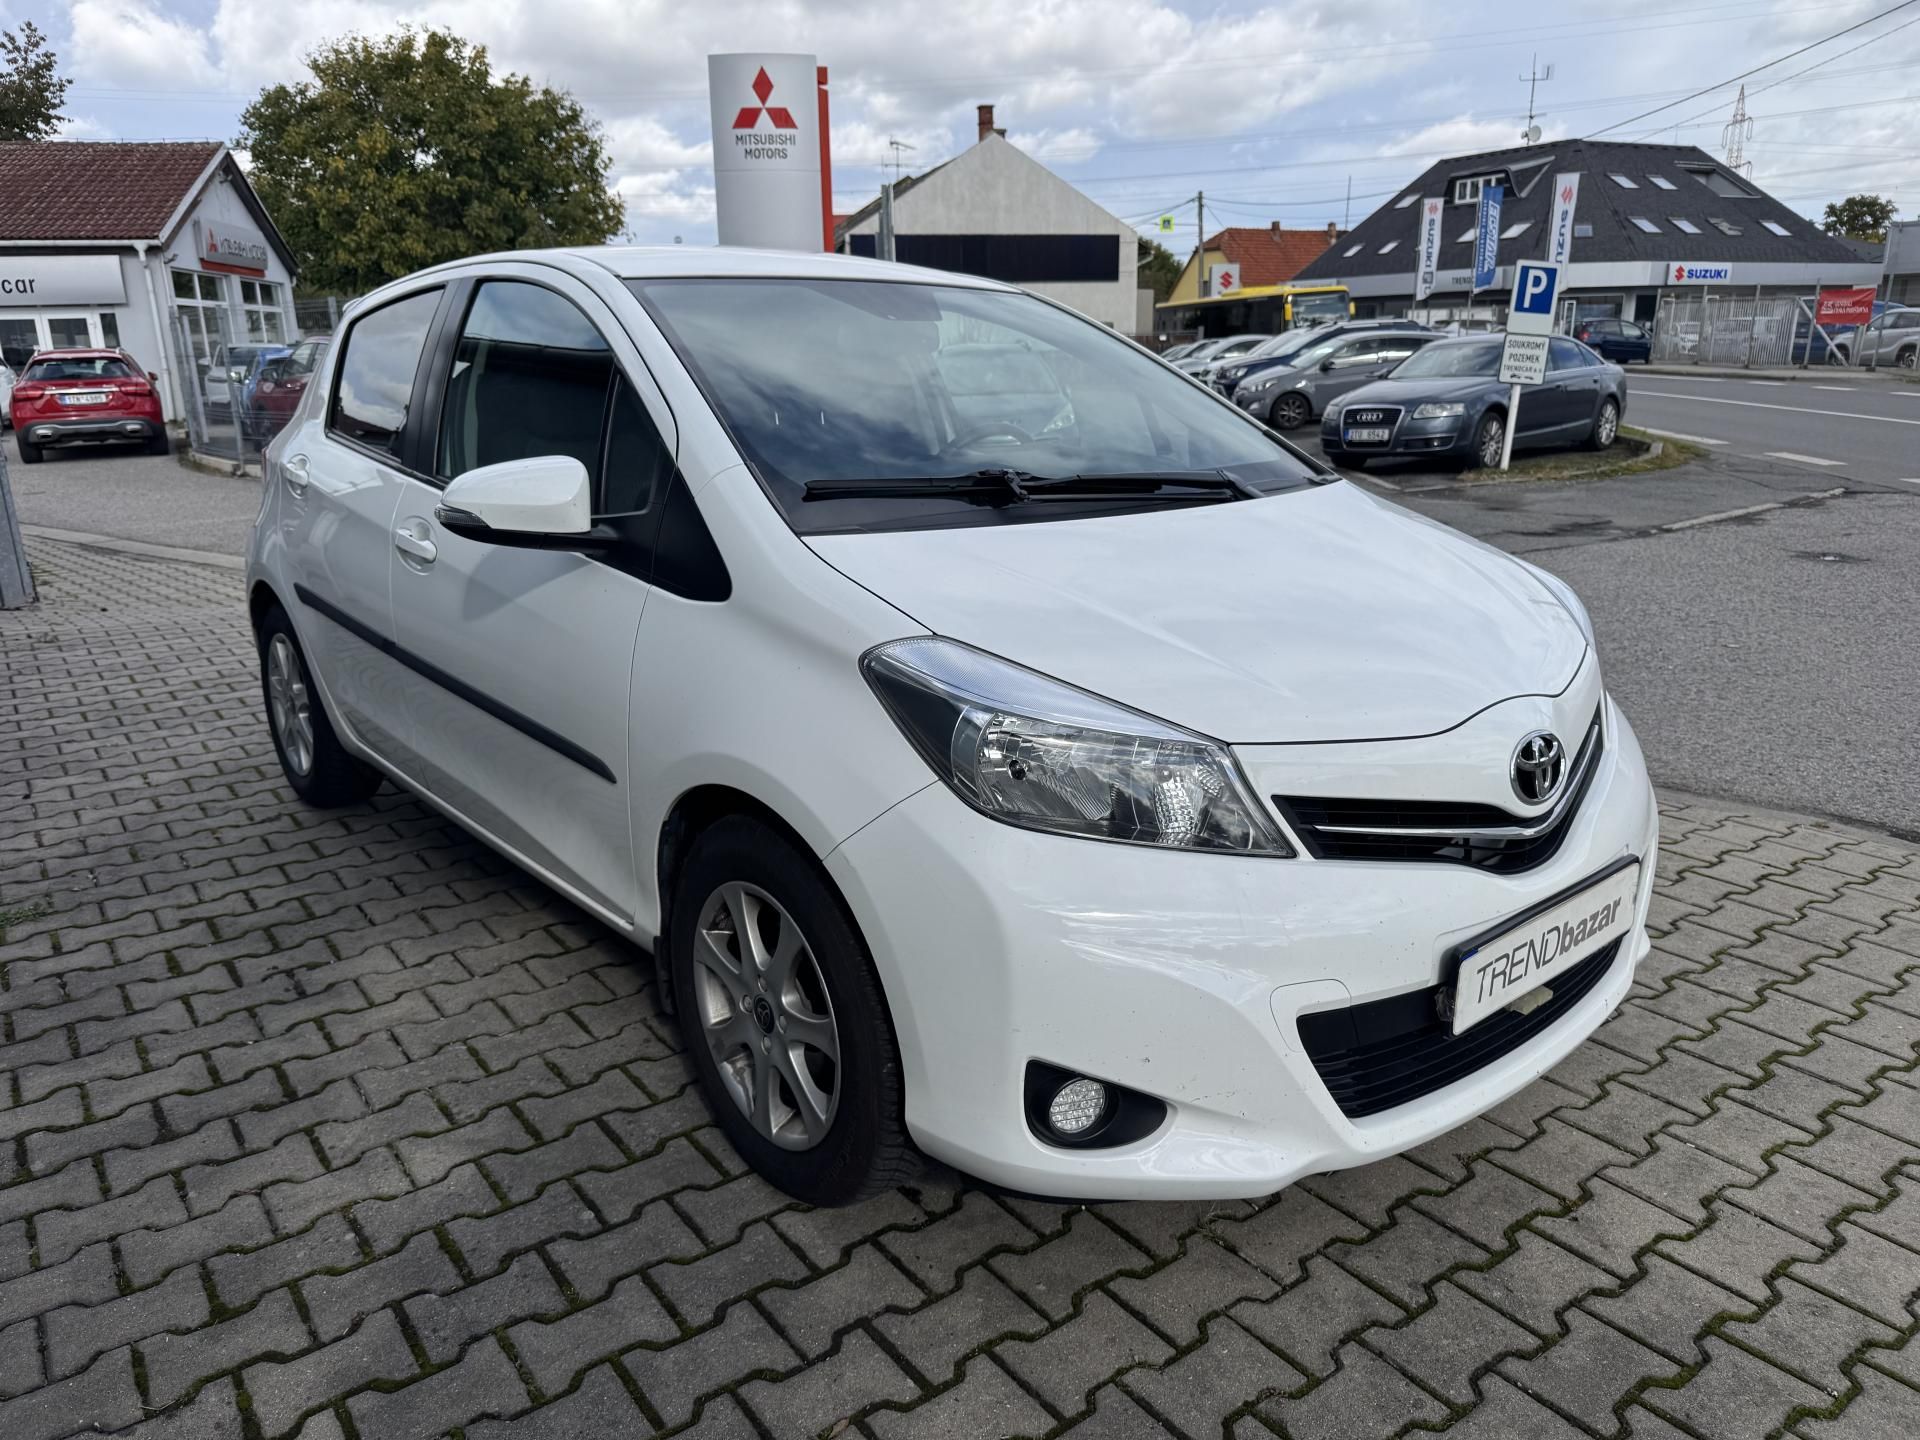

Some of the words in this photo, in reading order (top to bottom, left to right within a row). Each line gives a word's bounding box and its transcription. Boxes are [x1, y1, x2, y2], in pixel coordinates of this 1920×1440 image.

[735, 134, 796, 146] MITSUBISHI
[744, 148, 788, 160] MOTORS
[1425, 217, 1436, 268] SUZUKI
[1555, 209, 1568, 264] SUZU
[1687, 268, 1728, 279] SUZUKI
[1, 278, 35, 294] car
[1523, 268, 1548, 308] P
[1508, 352, 1540, 363] POZEMEK
[1477, 896, 1622, 1004] TRENDbazar
